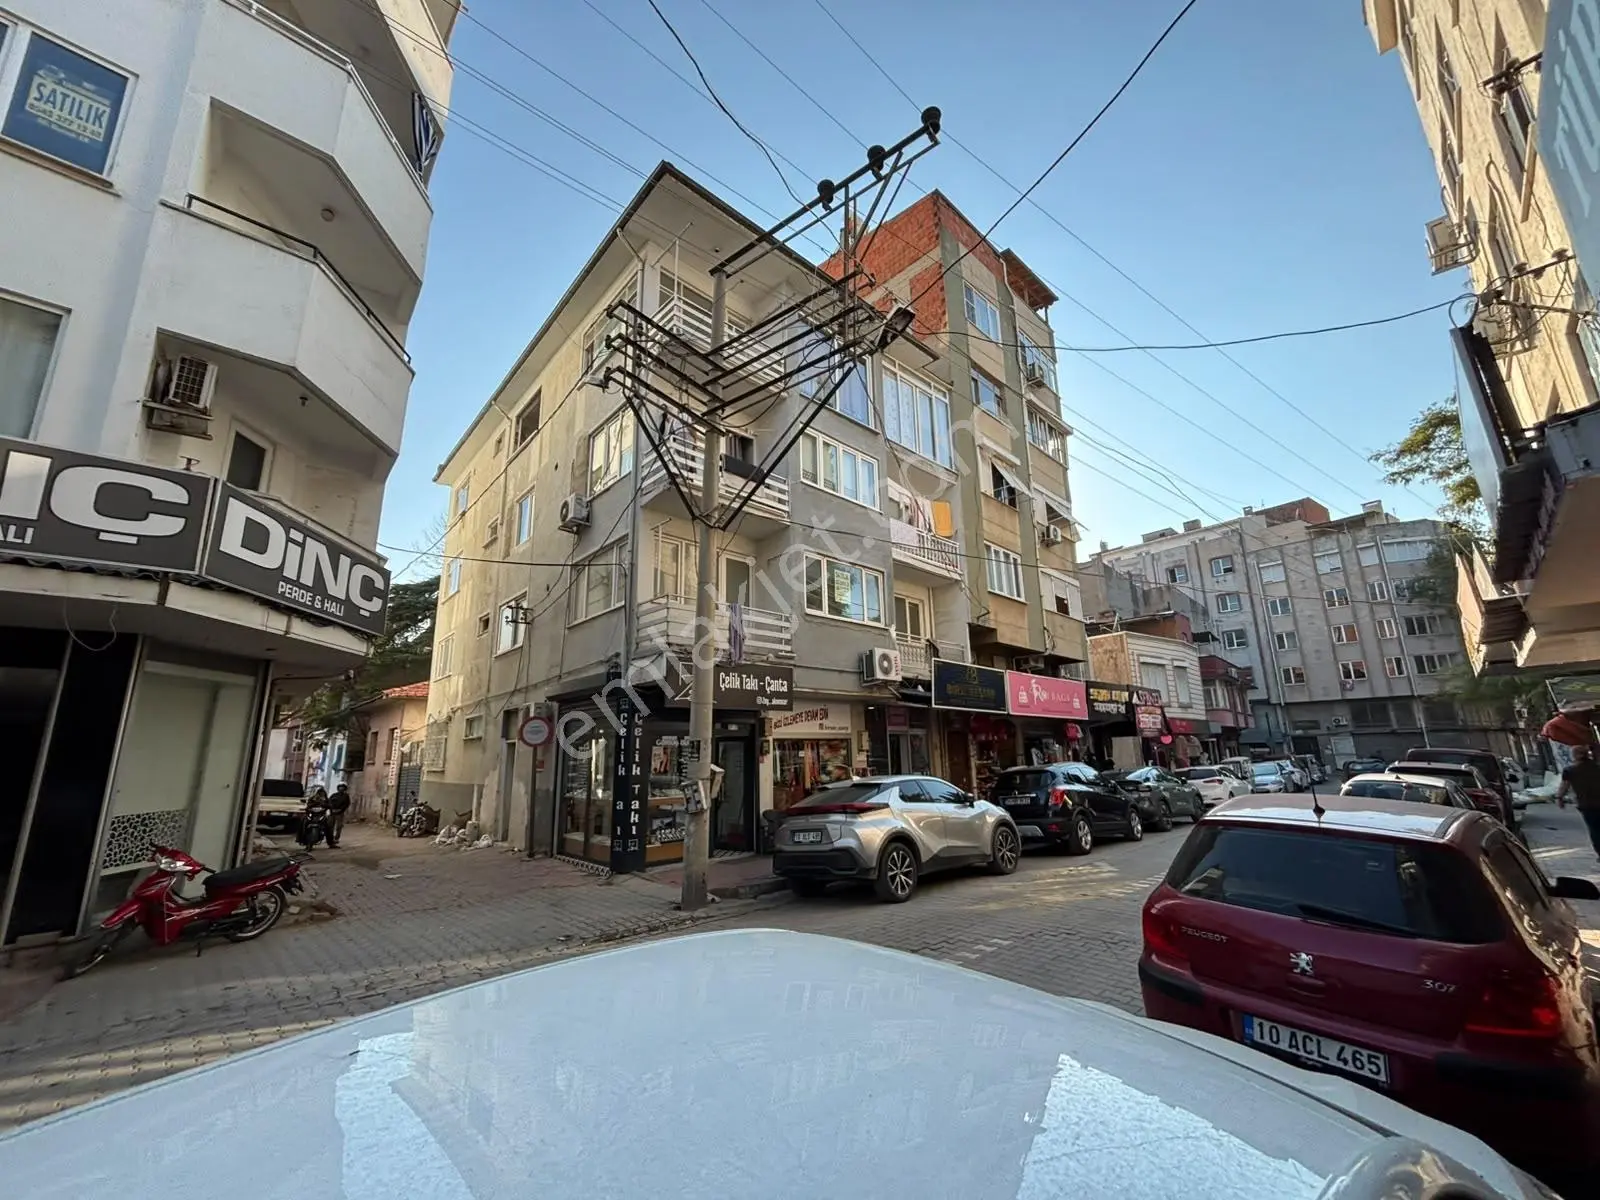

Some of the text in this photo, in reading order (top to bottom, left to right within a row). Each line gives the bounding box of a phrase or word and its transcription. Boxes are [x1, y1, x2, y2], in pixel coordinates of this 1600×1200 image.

[33, 82, 107, 129] SATILIK
[277, 581, 344, 617] PERDE & HALI
[719, 672, 740, 691] Çelik
[741, 674, 758, 690] Takı
[765, 676, 788, 694] Çanta
[631, 713, 643, 776] Çelik
[1181, 926, 1229, 943] PEUGEOT
[1423, 979, 1456, 993] 307
[1257, 1021, 1281, 1045] 10
[1288, 1031, 1330, 1061] ACL
[1336, 1045, 1382, 1076] 465
